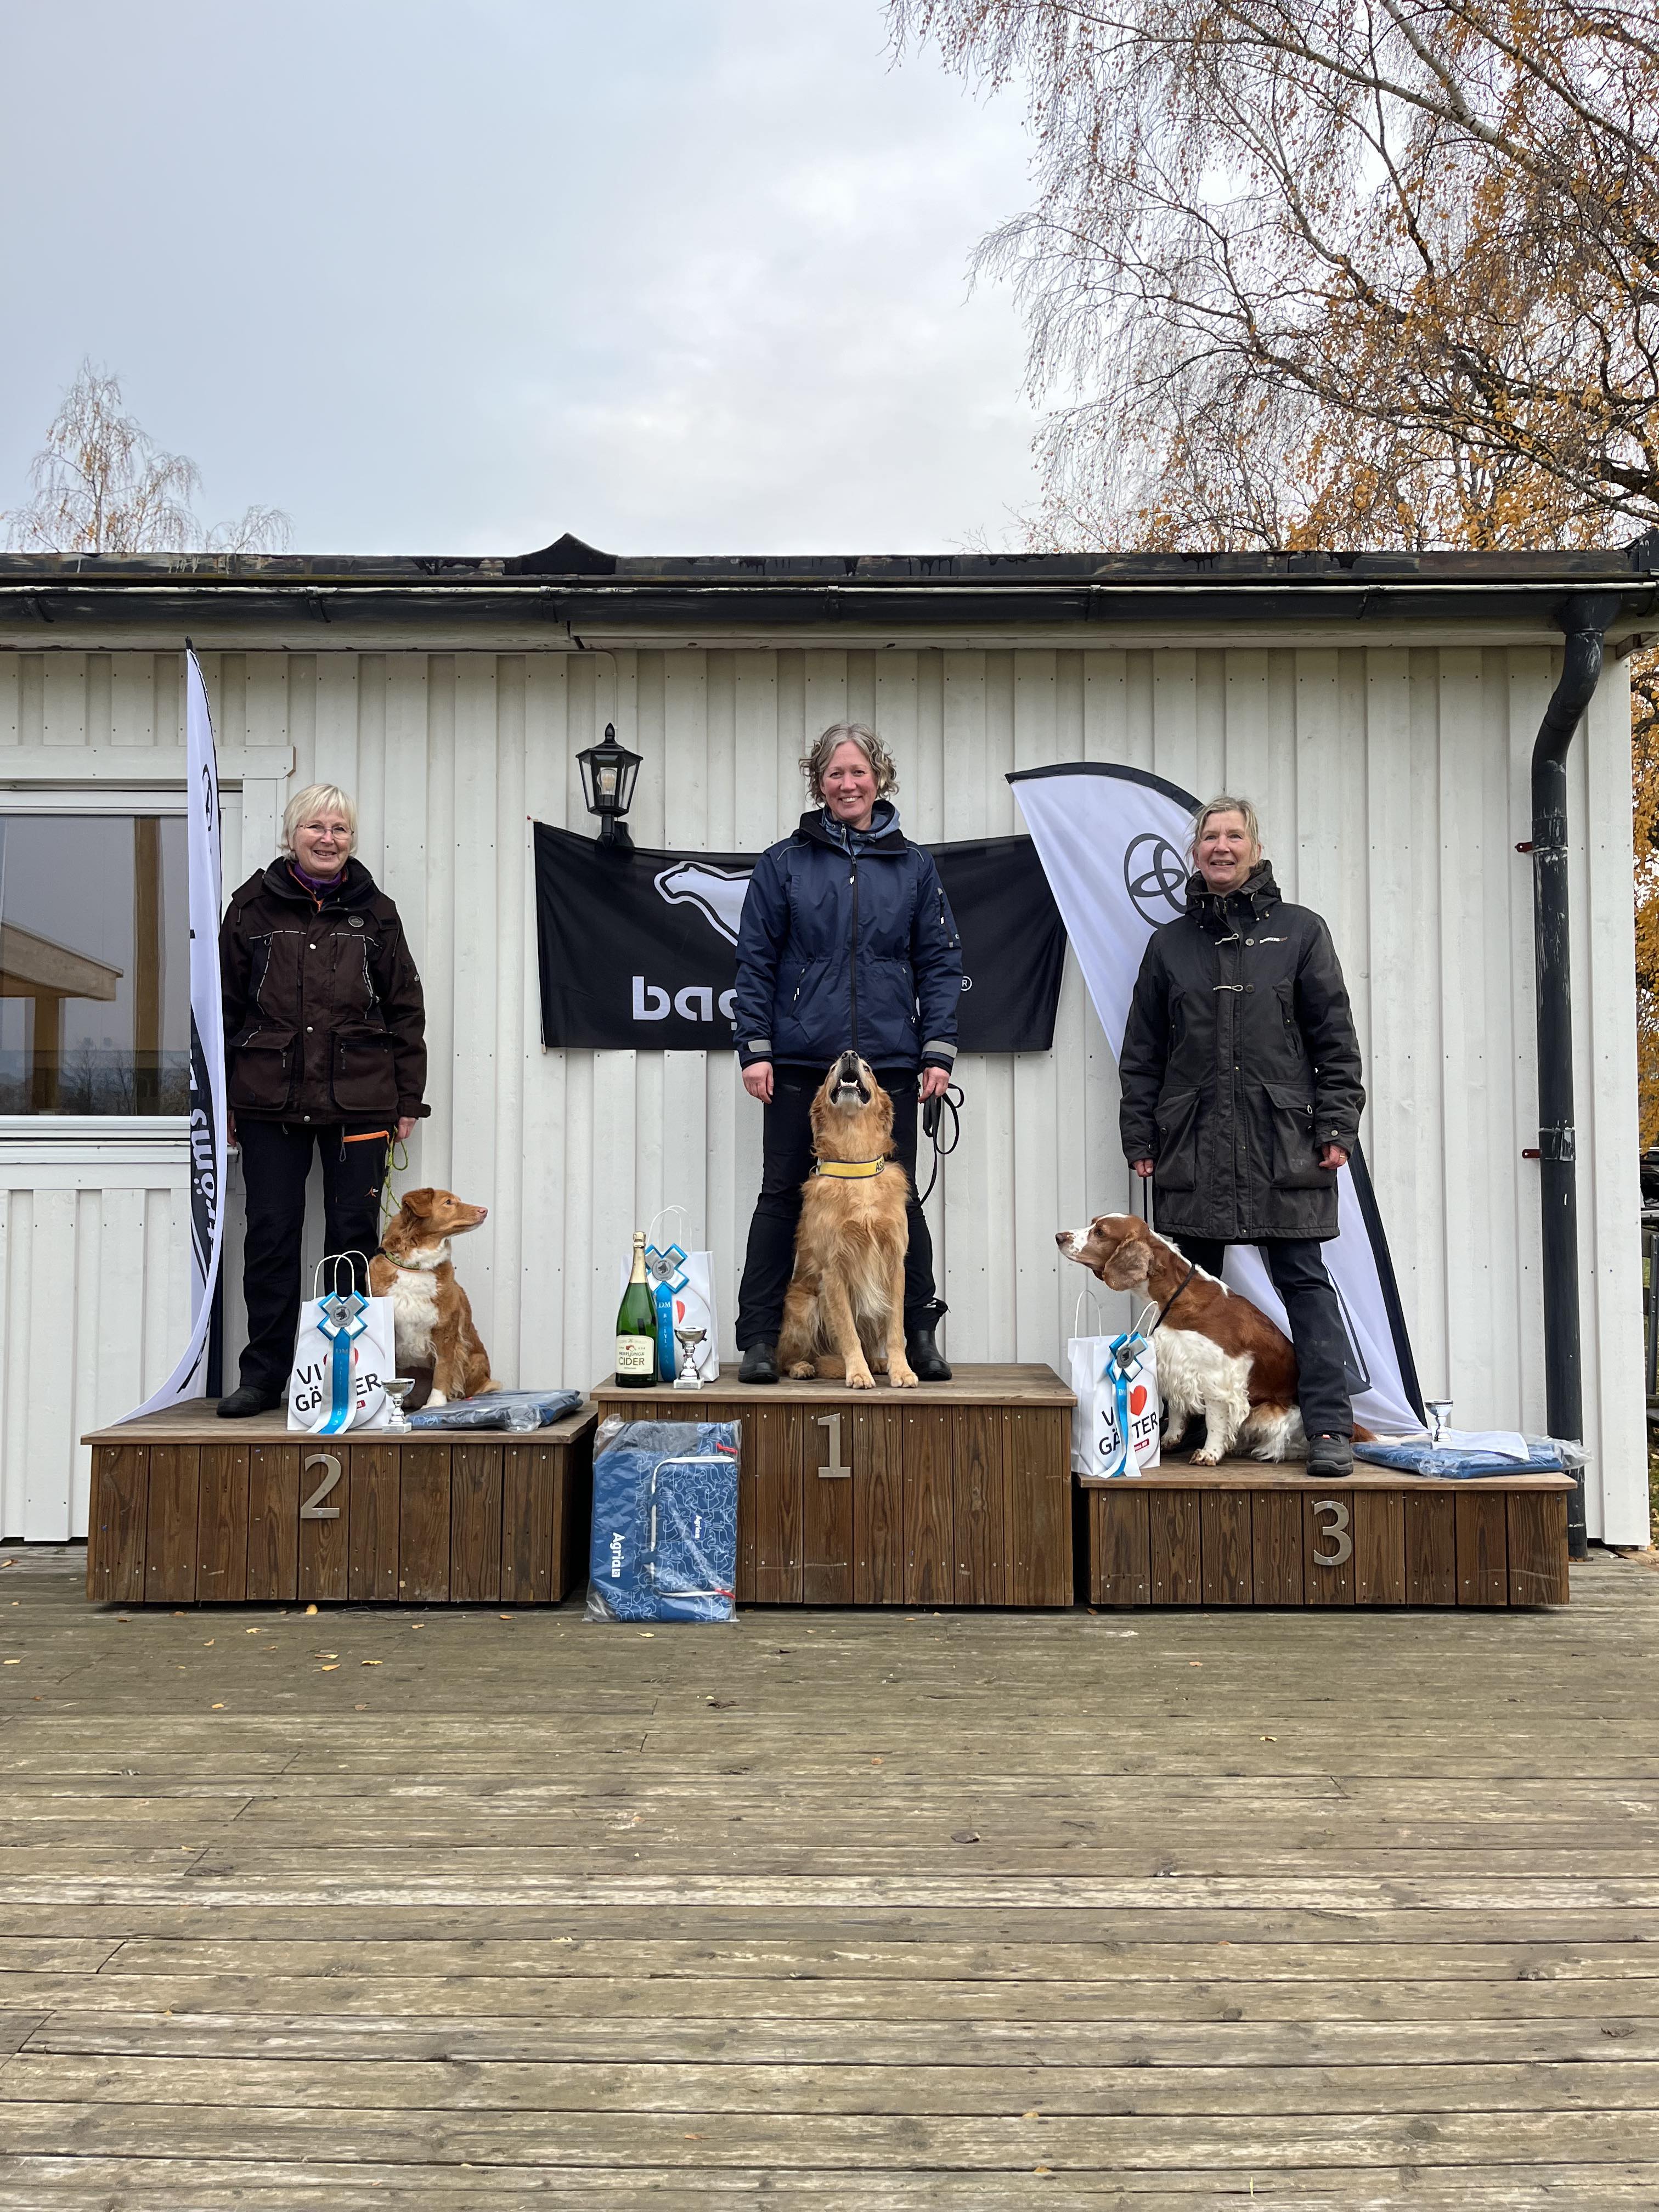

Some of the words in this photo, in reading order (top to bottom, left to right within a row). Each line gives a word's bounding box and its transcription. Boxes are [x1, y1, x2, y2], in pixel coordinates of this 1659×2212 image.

[296, 1364, 322, 1385] VI
[618, 1357, 645, 1365] CIDER
[295, 1373, 381, 1412] GÄER
[817, 1413, 851, 1478] 1
[1099, 1411, 1159, 1455] GÄTER
[300, 1453, 342, 1519] 2
[693, 1515, 702, 1533] Agria
[1313, 1500, 1352, 1566] 3
[610, 1532, 625, 1568] Agria
